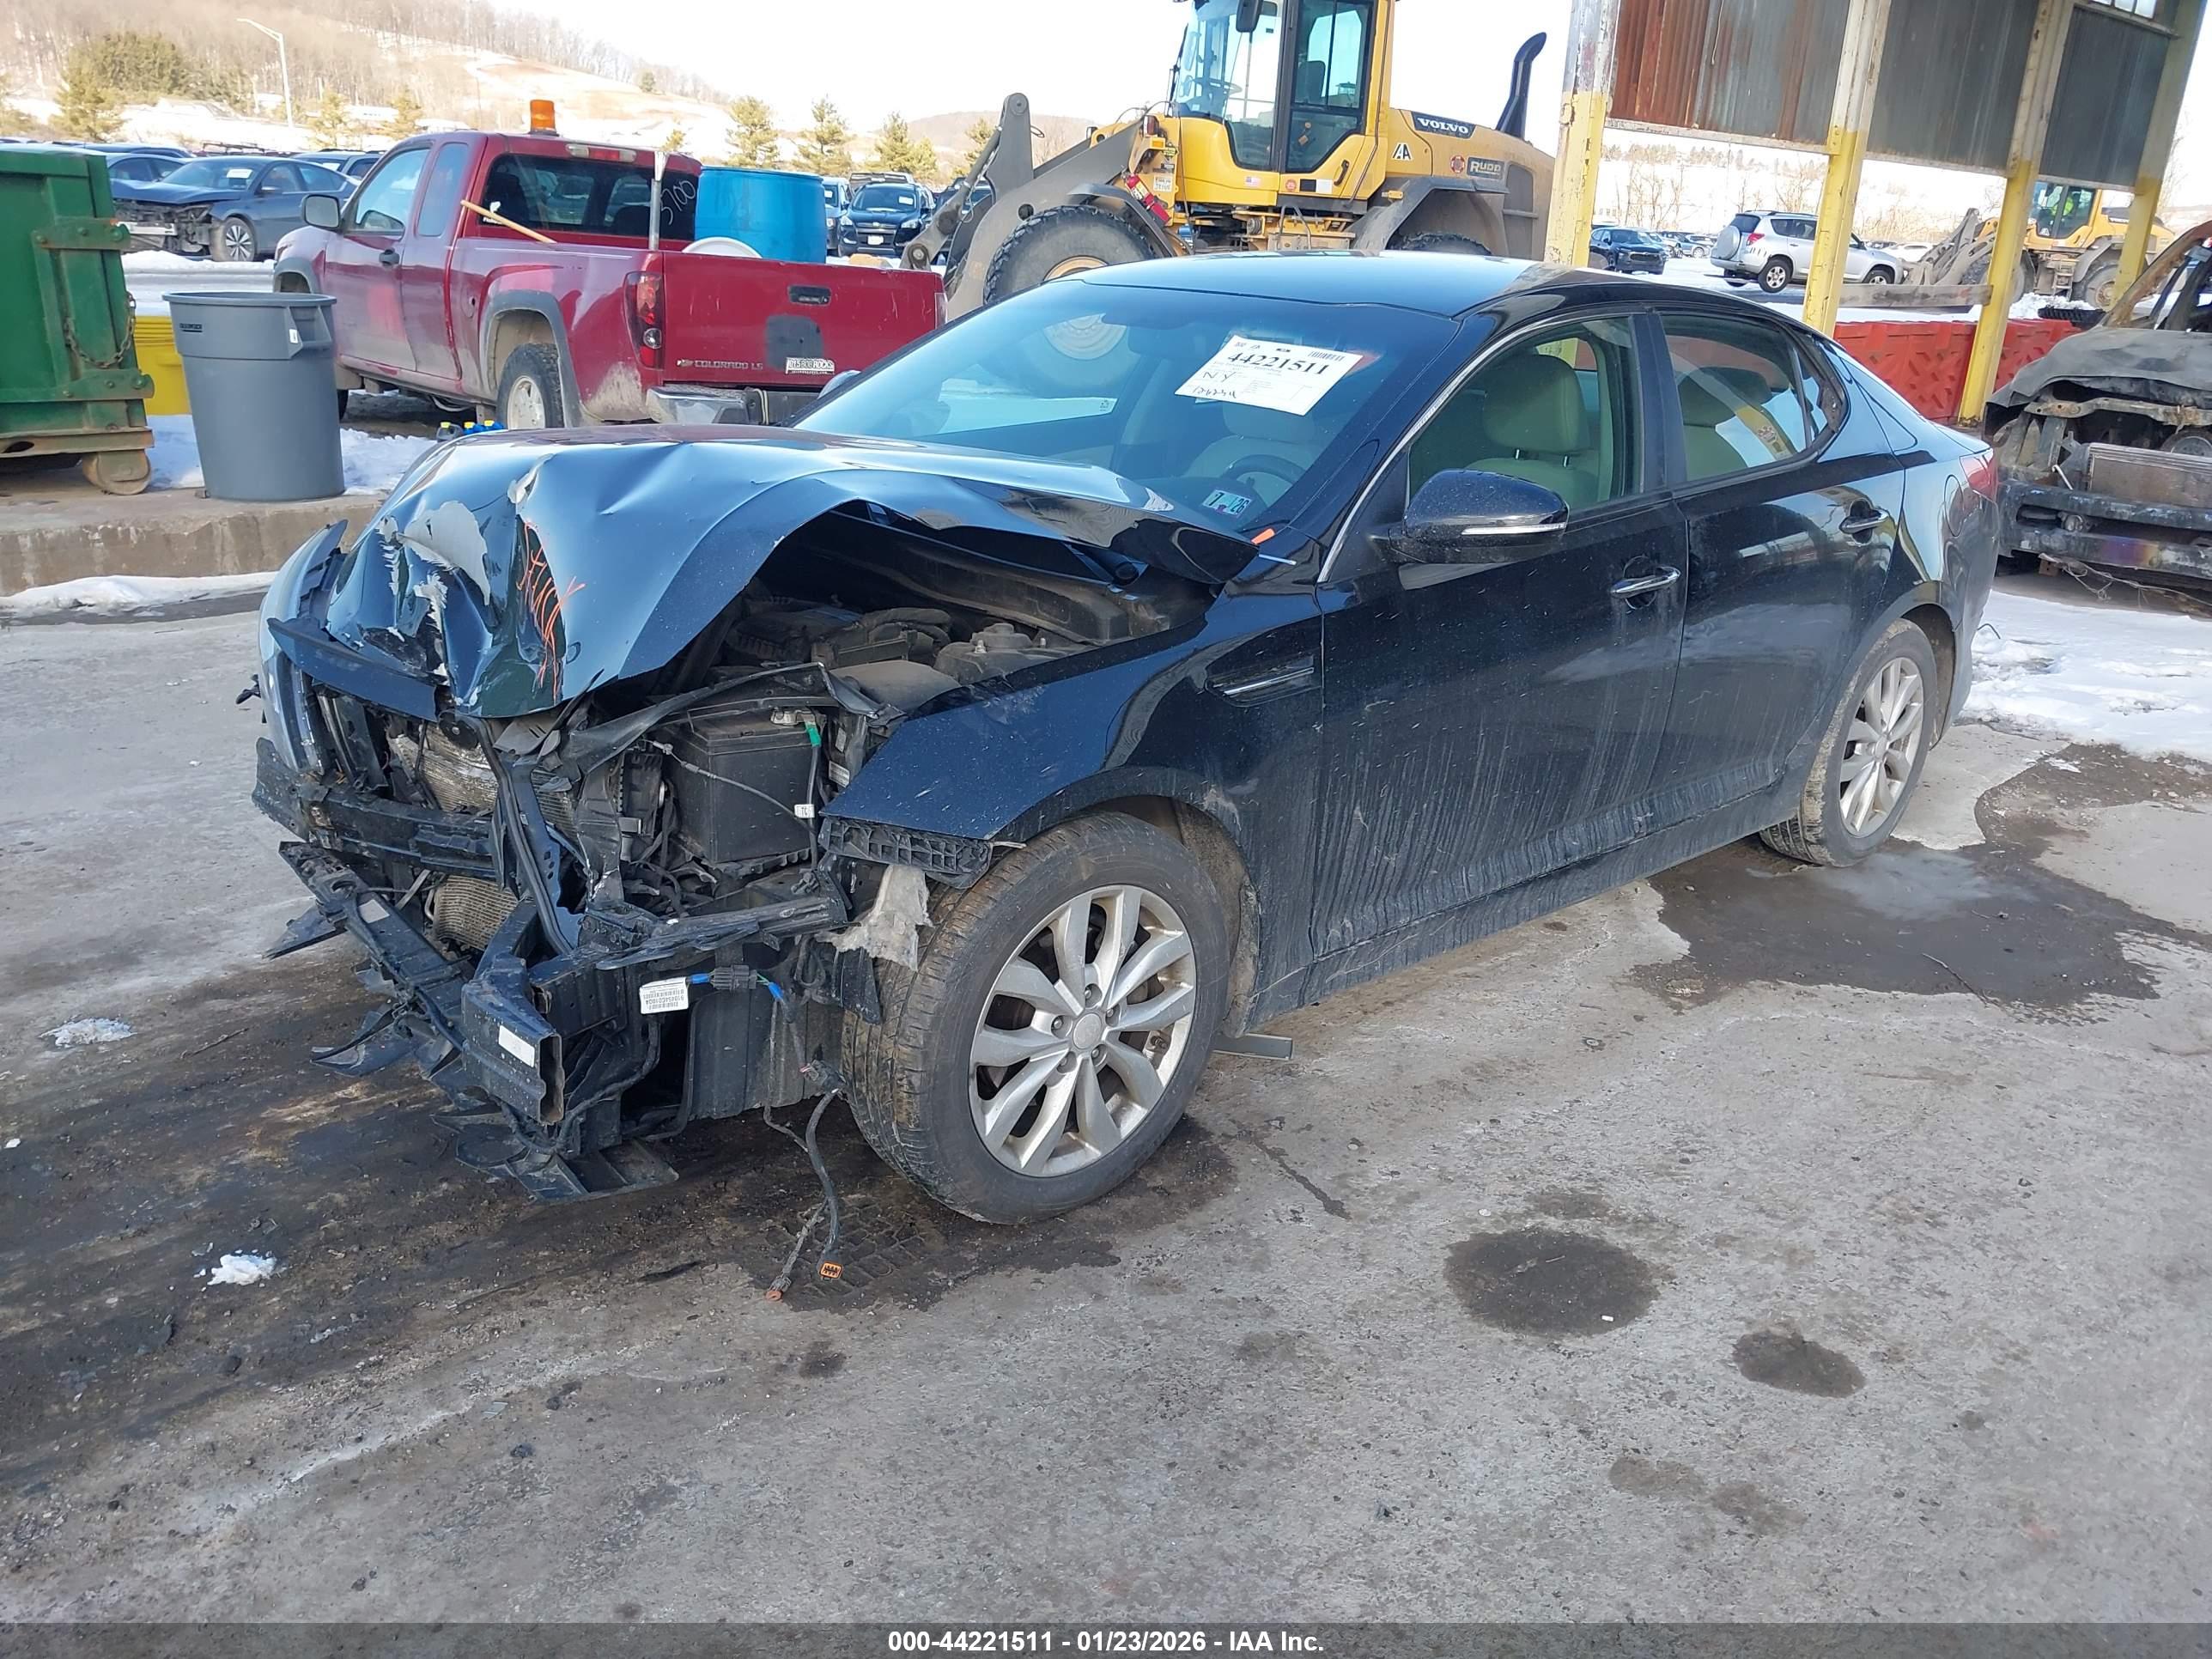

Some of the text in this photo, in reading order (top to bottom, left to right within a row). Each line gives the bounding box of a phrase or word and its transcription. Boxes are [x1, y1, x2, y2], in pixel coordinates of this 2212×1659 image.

[1417, 117, 1469, 135] VOLVO
[1470, 161, 1502, 173] RUDD
[695, 360, 763, 370] COLORADO LS
[1227, 352, 1330, 375] 44221511
